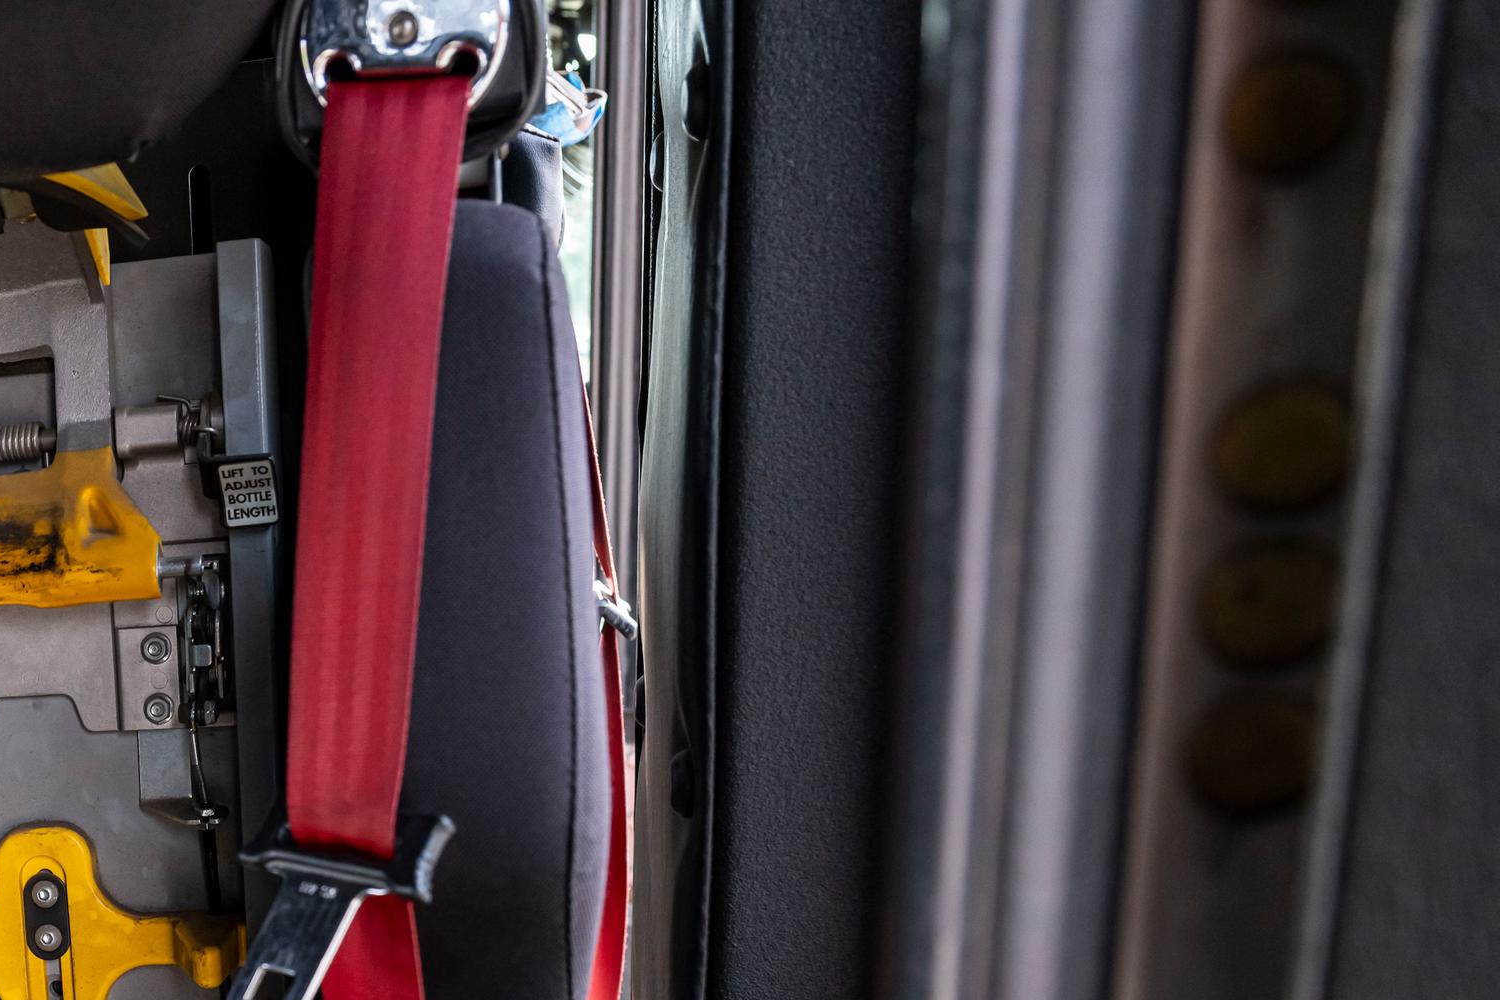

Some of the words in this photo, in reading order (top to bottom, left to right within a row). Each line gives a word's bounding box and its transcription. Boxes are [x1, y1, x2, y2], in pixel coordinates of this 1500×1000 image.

[221, 468, 244, 479] LIFT
[251, 466, 269, 475] TO
[225, 478, 272, 491] ADJUST
[228, 491, 272, 504] BOTTLE
[228, 505, 276, 520] LENGTH
